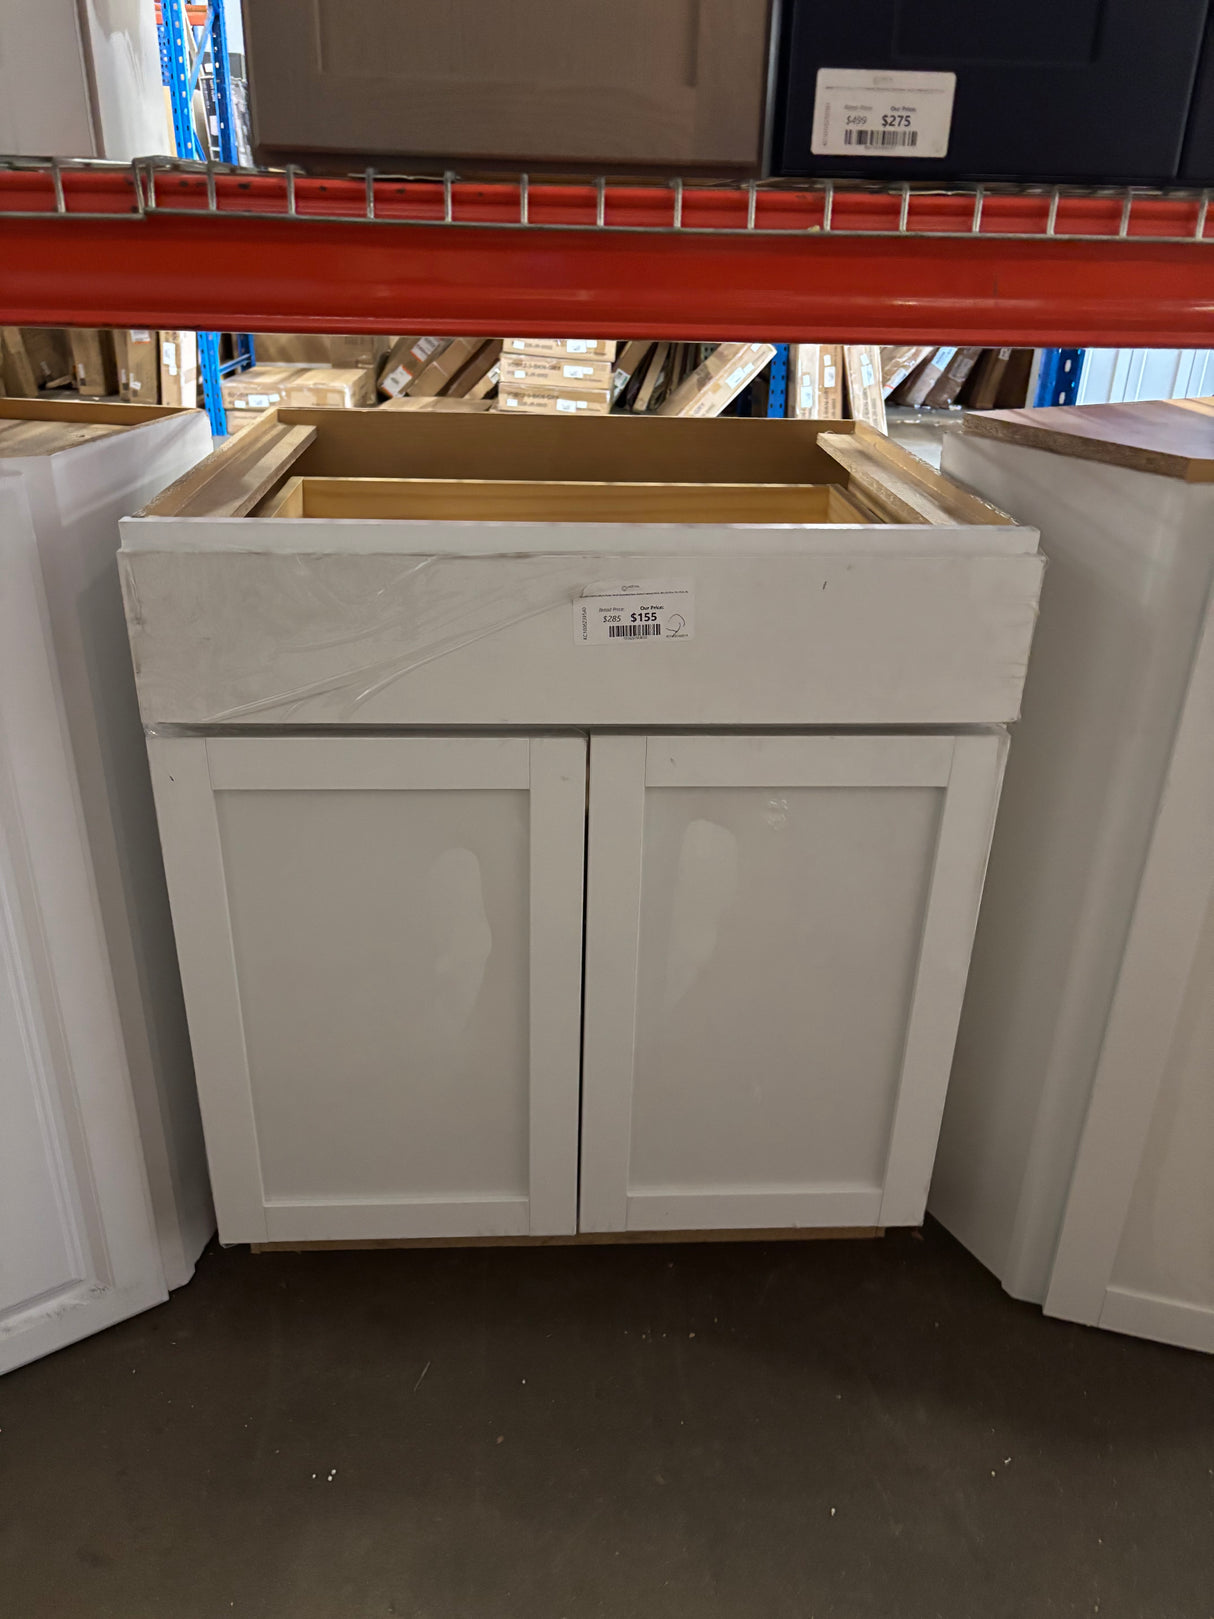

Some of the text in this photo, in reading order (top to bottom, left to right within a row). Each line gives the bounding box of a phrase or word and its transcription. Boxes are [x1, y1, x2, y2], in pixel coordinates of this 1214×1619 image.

[846, 115, 867, 126] $499
[881, 114, 911, 128] $275
[603, 614, 622, 623] $285
[630, 612, 658, 623] $155
